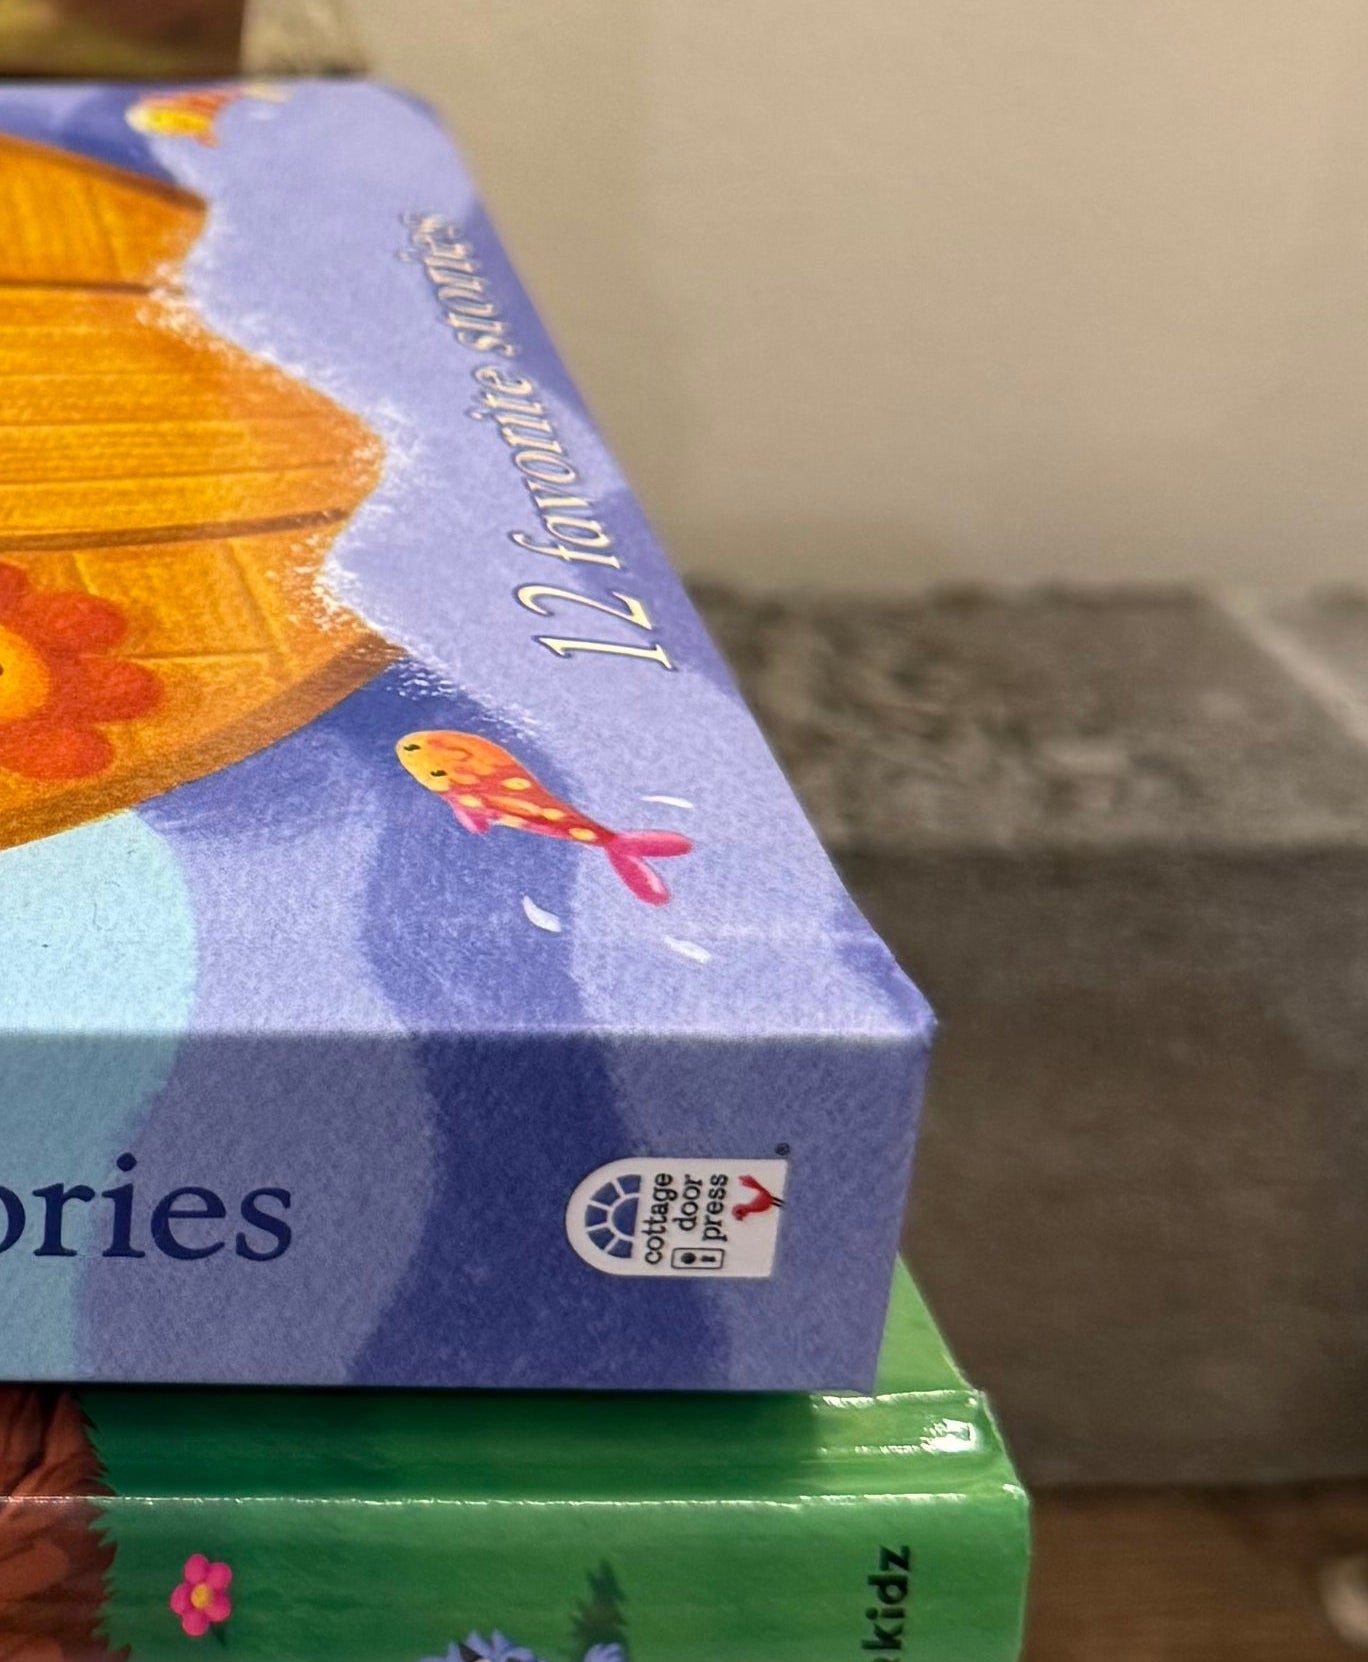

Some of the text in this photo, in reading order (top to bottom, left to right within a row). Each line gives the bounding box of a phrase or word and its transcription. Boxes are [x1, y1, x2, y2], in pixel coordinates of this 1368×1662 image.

[466, 365, 622, 570] favorite
[513, 583, 677, 671] 12
[641, 1172, 678, 1265] cottage
[672, 1173, 703, 1232] door
[701, 1173, 729, 1243] press
